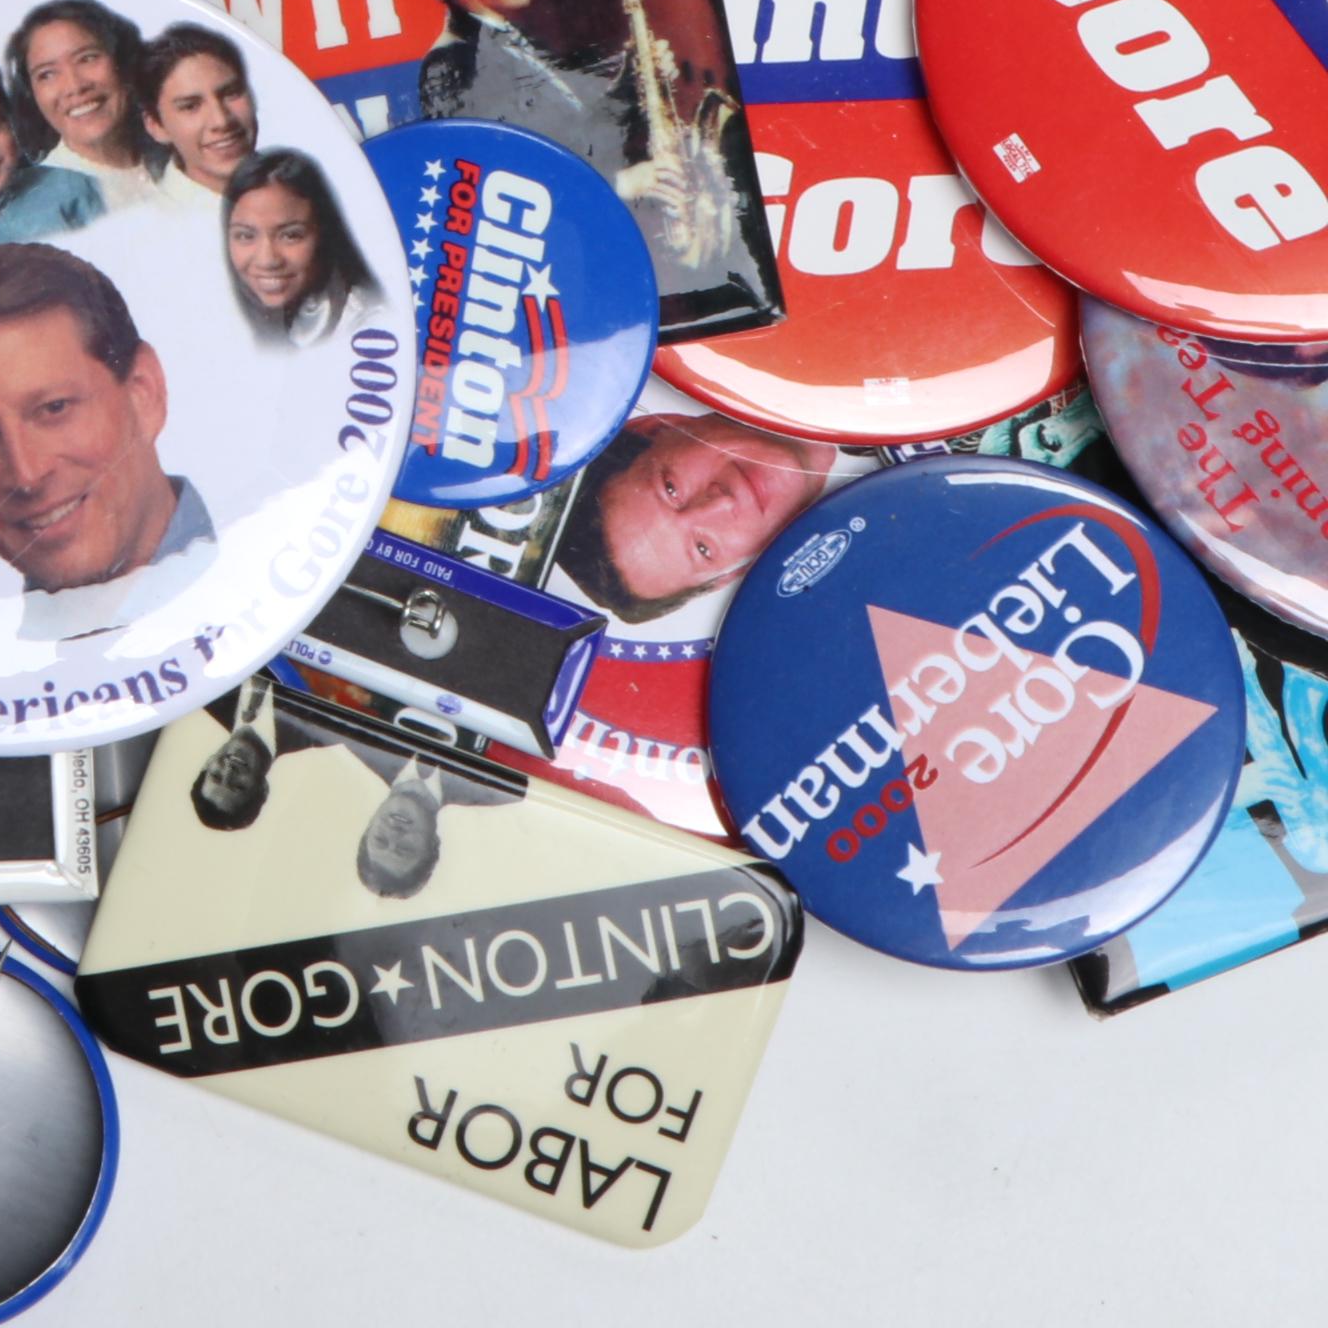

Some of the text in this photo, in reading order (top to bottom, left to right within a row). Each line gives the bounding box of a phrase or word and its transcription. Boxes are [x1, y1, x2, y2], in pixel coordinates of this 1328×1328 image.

[411, 159, 481, 457] FOR PRESIDENT
[442, 170, 552, 468] Clinton
[269, 469, 370, 598] Gore
[338, 327, 399, 453] 2000
[1177, 421, 1261, 531] The
[376, 541, 394, 558] BY
[395, 549, 420, 569] FOR
[424, 560, 452, 581] PAID
[741, 523, 1136, 861] Lieberman
[946, 604, 1144, 784] Gore
[74, 798, 89, 823] OH
[75, 827, 91, 875] 43605
[826, 754, 938, 864] 2000
[147, 891, 774, 1056] CLINTON GORE
[564, 1041, 703, 1144] FOR
[406, 1075, 672, 1233] LABOR
